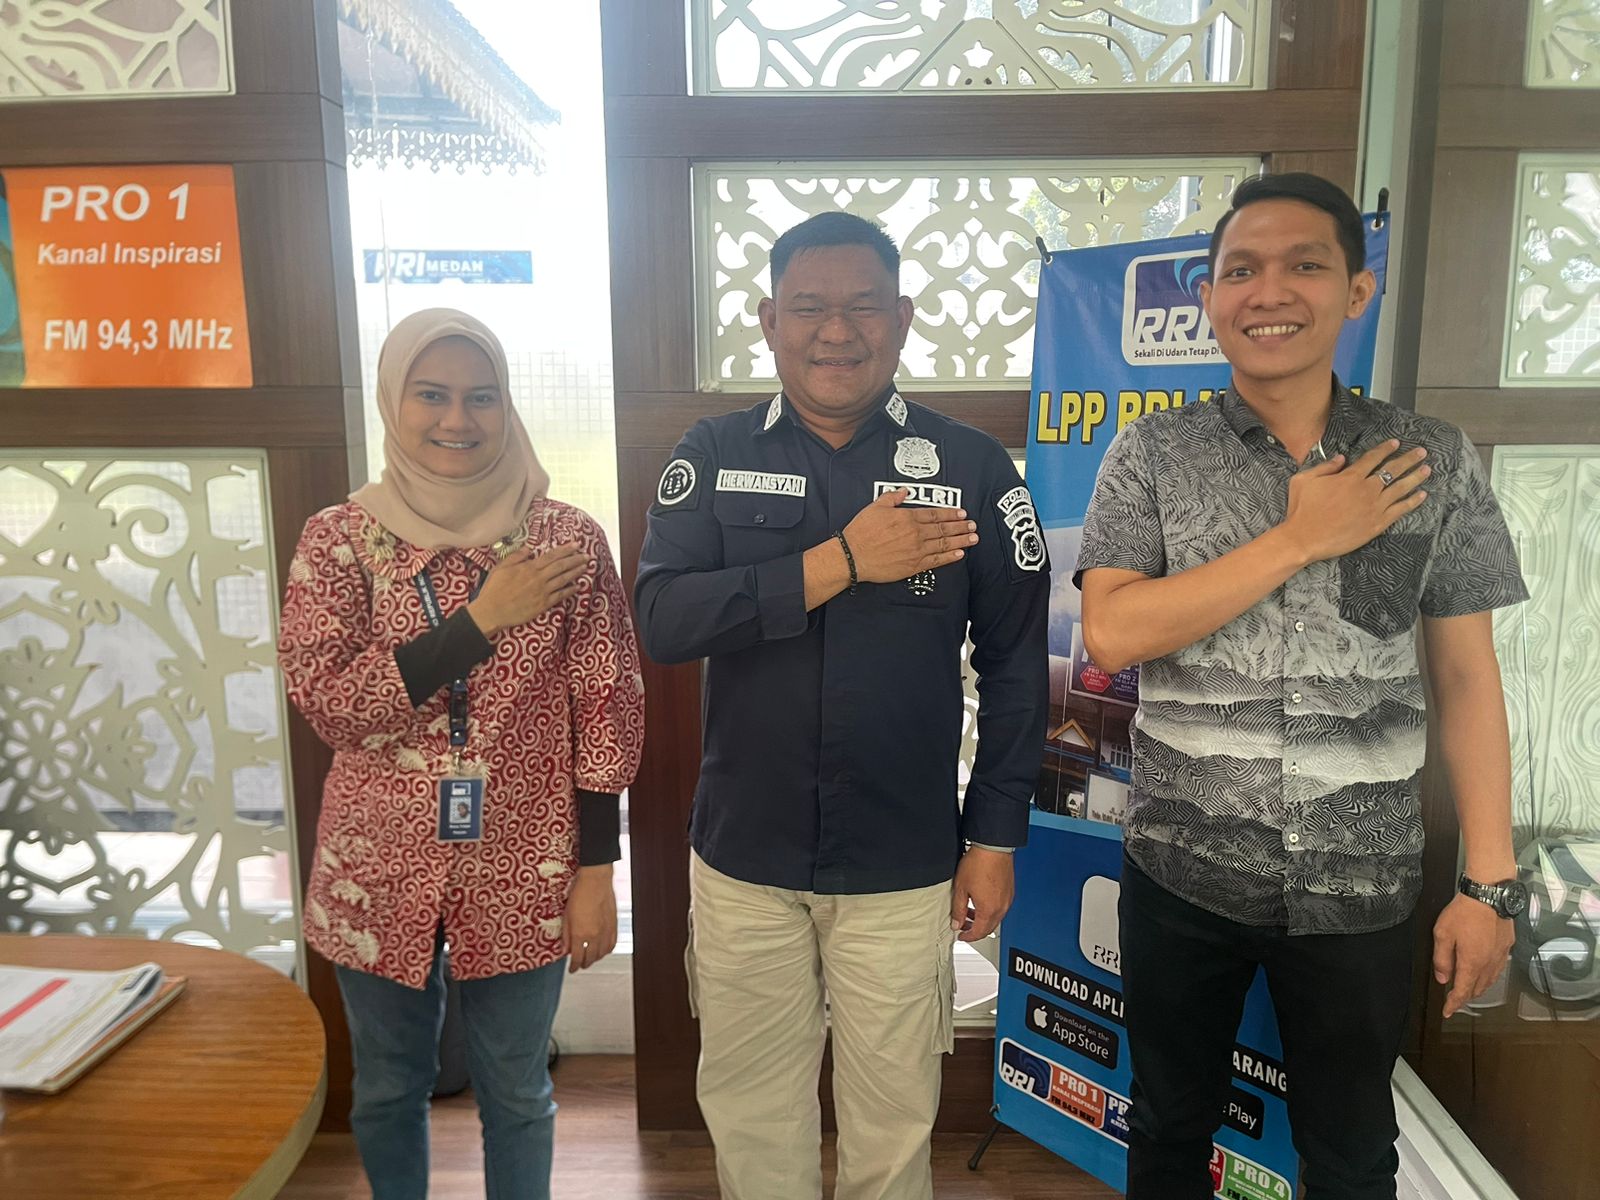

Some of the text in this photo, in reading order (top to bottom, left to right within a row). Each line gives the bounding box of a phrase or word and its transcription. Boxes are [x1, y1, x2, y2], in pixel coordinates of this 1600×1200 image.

[40, 183, 189, 222] PRO 1
[37, 242, 222, 268] Kanal Inspirasi
[426, 260, 484, 272] MEDAN
[44, 318, 233, 355] FM 94,3 MHz
[1134, 346, 1220, 358] Sekali Di Udara Tetap Di
[1036, 391, 1106, 443] LPP
[722, 473, 801, 493] HERWANSYAH
[1093, 944, 1120, 969] RR
[1015, 956, 1124, 1018] DOWNLOAD APLI
[1052, 1022, 1109, 1059] App Store
[1054, 1011, 1110, 1041] Download on the
[1001, 1062, 1036, 1094] RRI
[1059, 1071, 1098, 1103] PRO 1
[1228, 1102, 1257, 1130] Play
[1233, 1158, 1270, 1189] PRO
[1274, 1180, 1286, 1198] 4
